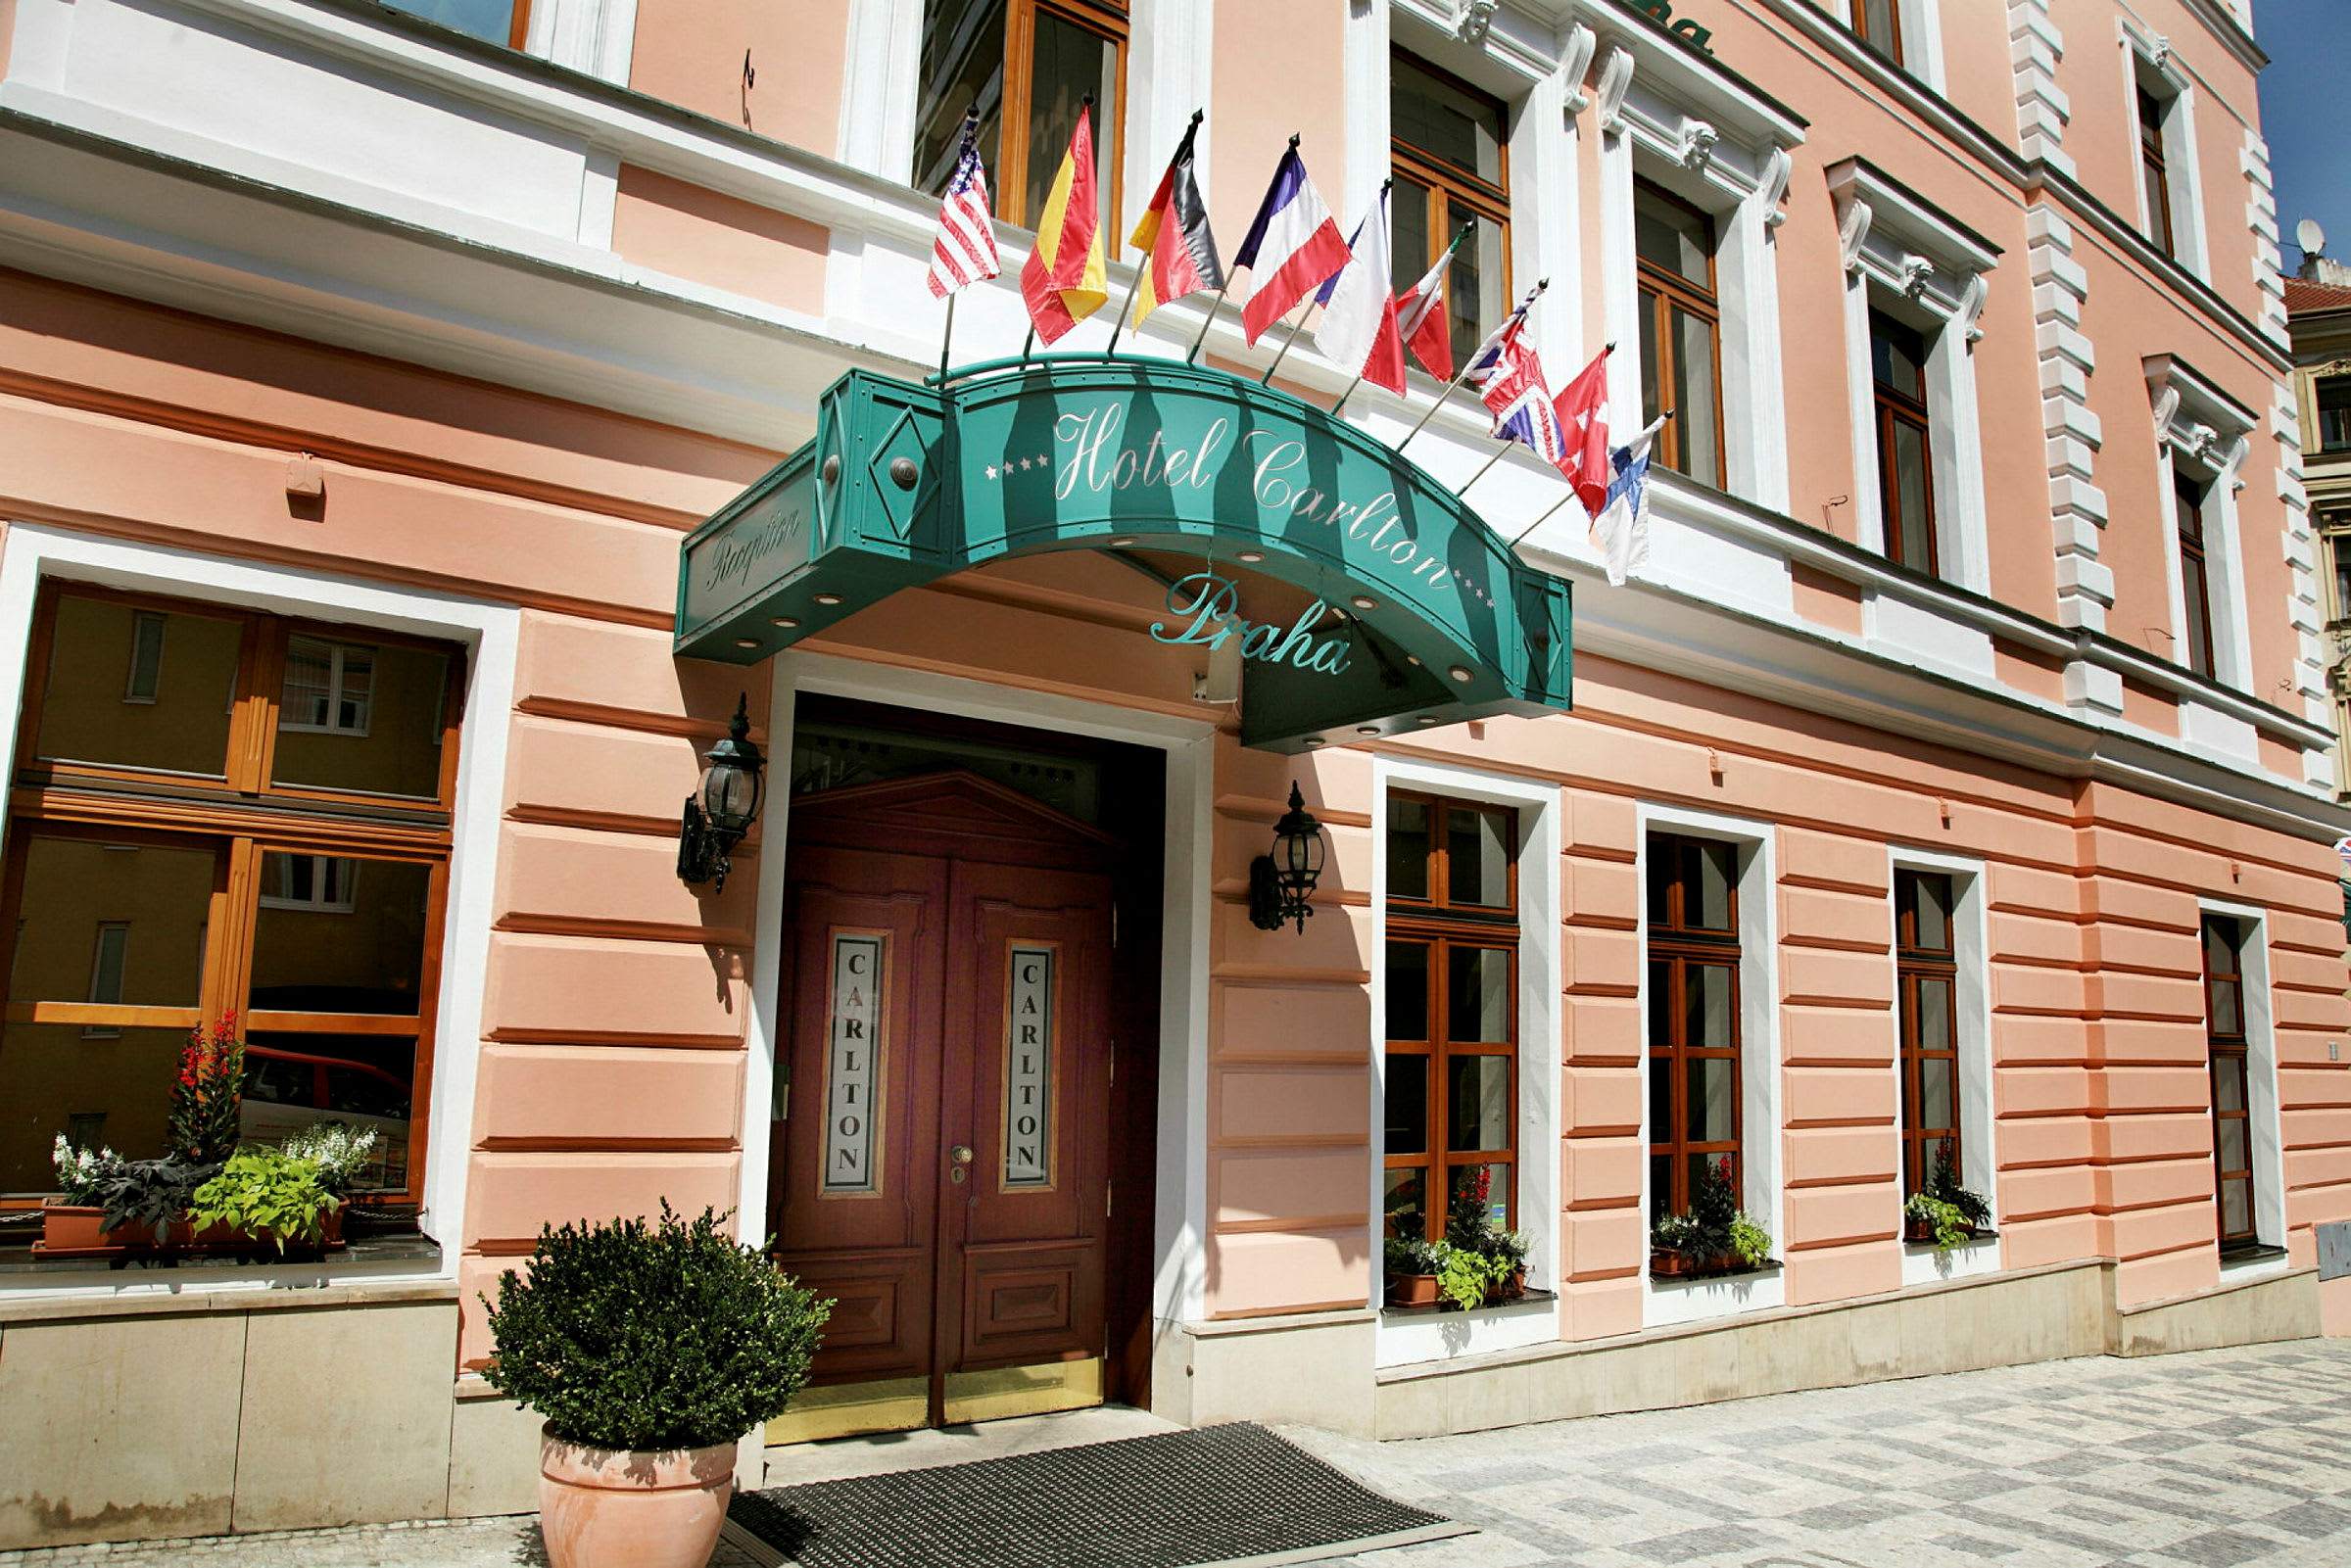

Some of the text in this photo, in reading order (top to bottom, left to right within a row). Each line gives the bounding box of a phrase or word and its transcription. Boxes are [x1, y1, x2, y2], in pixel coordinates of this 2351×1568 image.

[705, 507, 800, 593] Reception
[1054, 401, 1450, 590] Hotel Carlton
[1150, 572, 1352, 676] Praha
[838, 953, 866, 1170] CARLTON
[1016, 963, 1038, 1167] CARLTON
